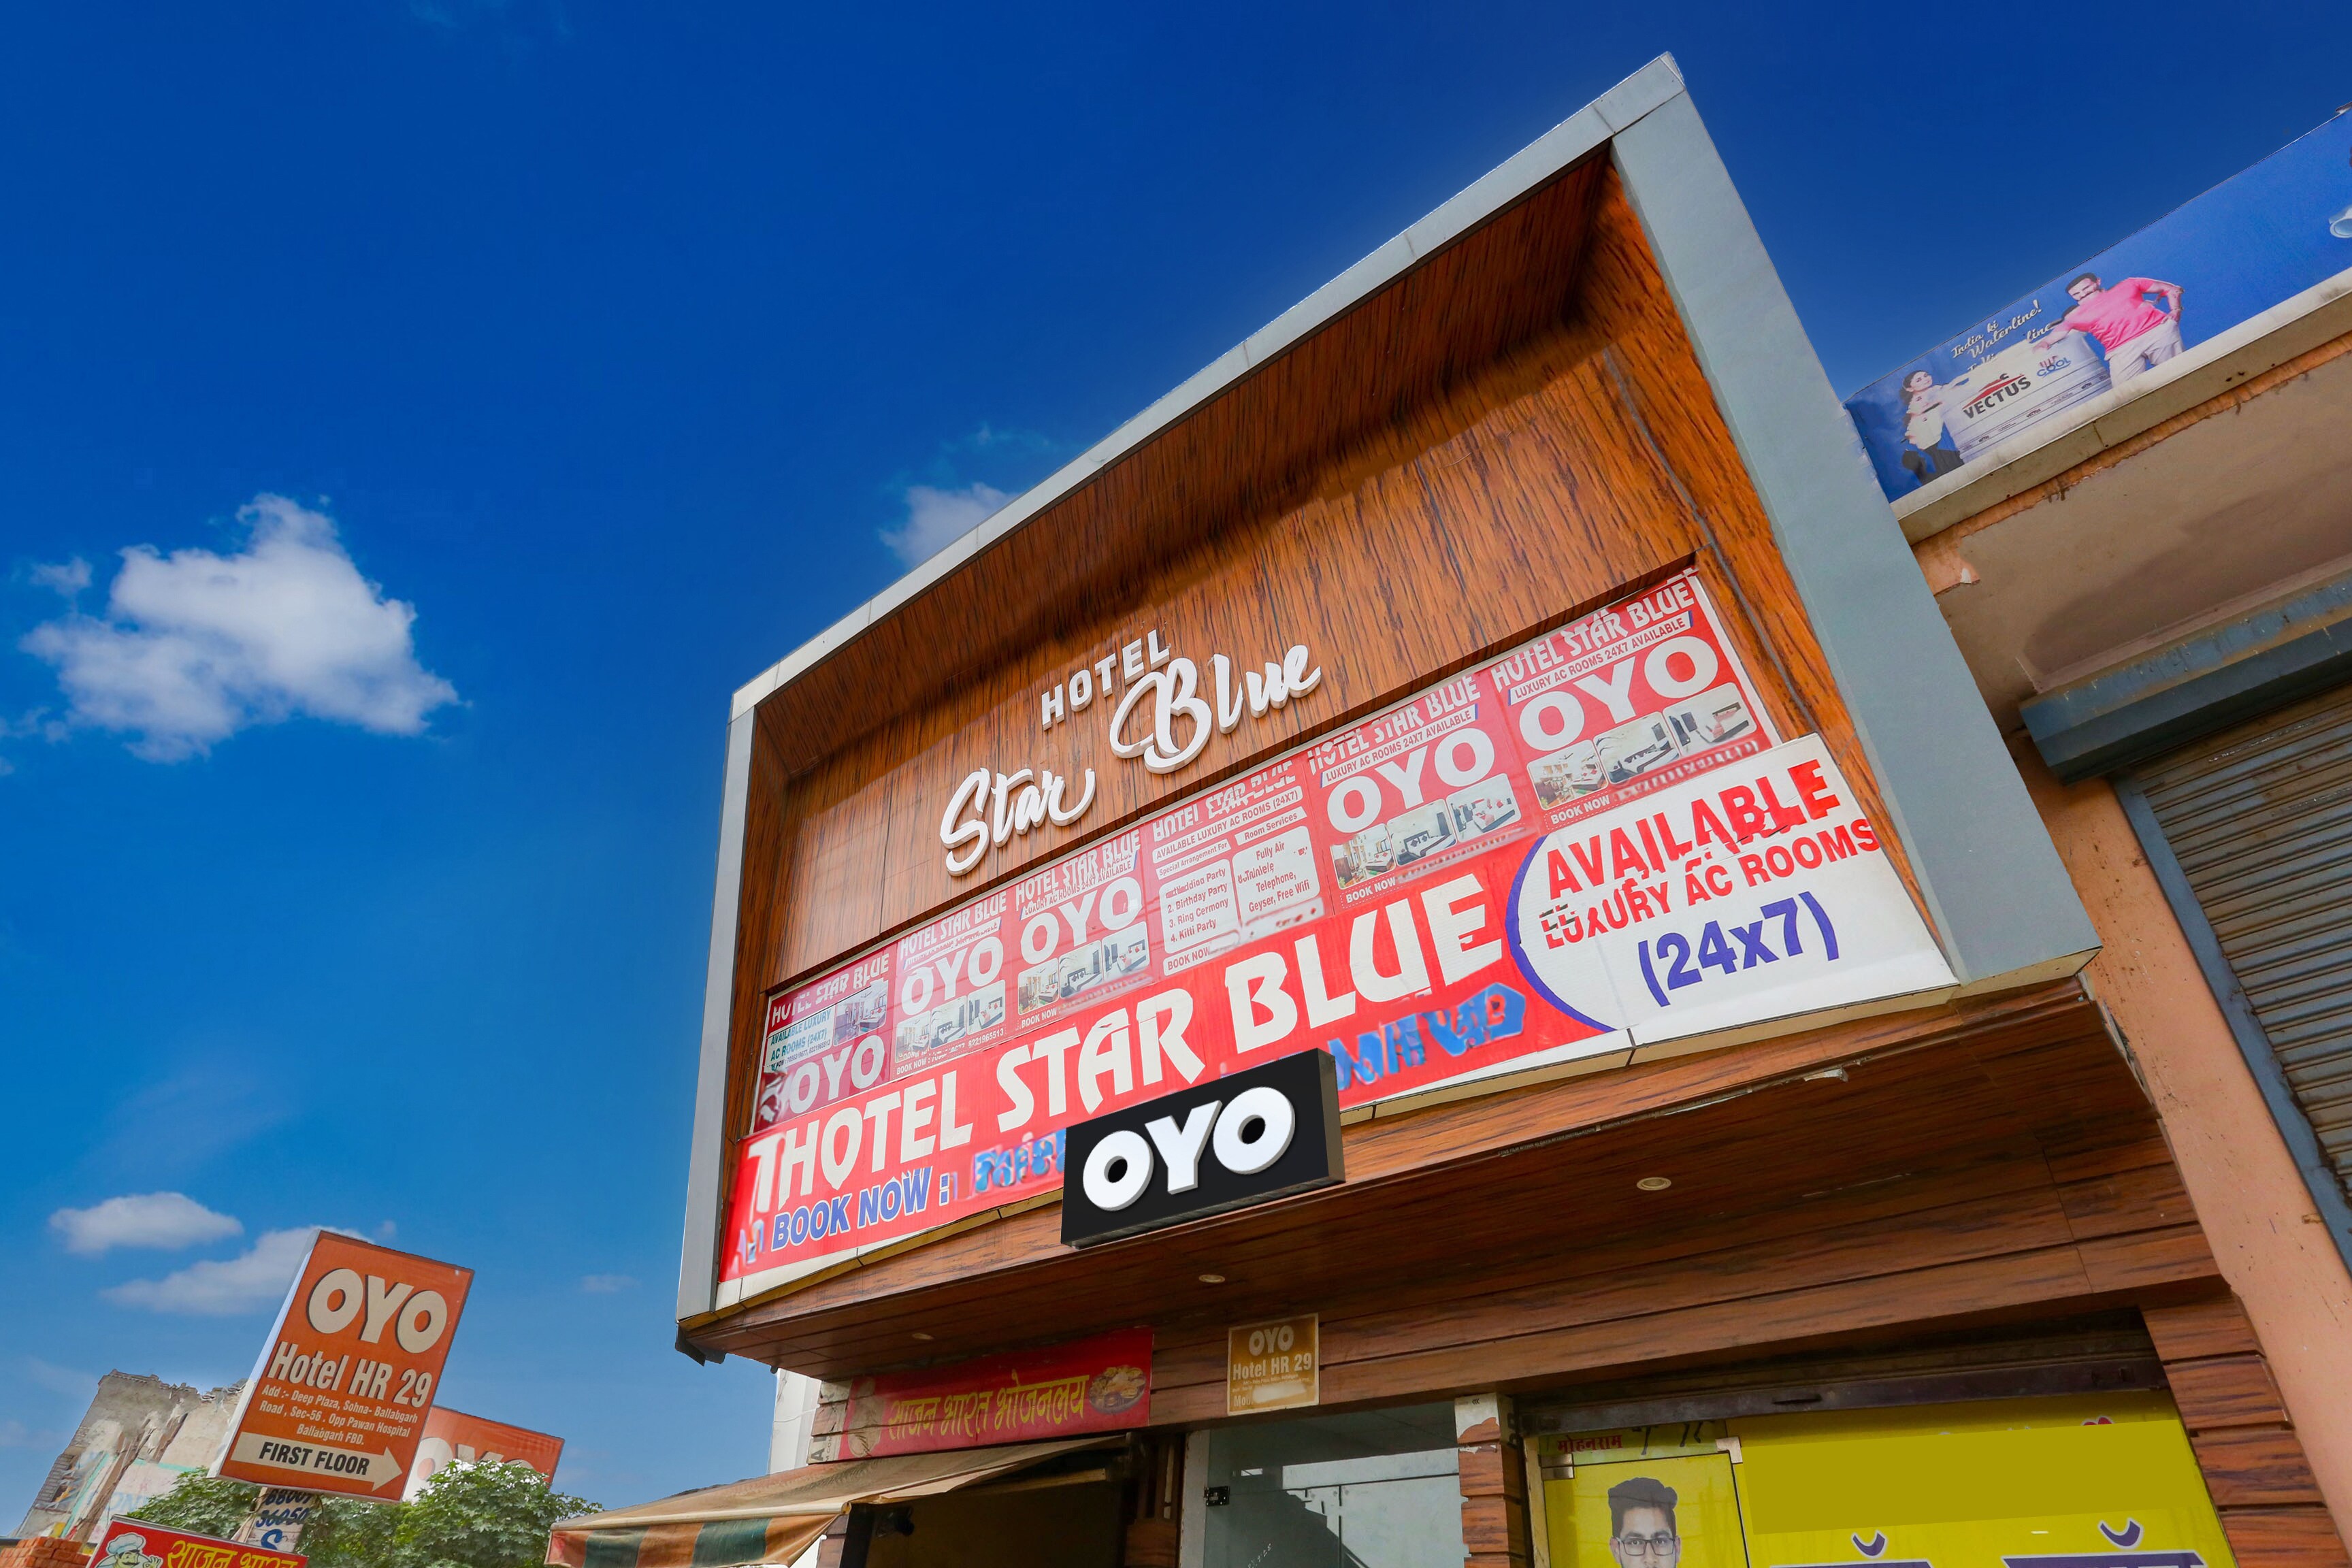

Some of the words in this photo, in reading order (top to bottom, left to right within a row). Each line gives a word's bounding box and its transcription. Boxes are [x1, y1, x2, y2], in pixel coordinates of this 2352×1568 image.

[1951, 334, 1984, 358] India
[1987, 321, 1998, 333] ki
[1967, 299, 2042, 358] Waterline!
[1963, 377, 2031, 419] VECTUS
[1490, 647, 1563, 691] HOTEL
[1563, 607, 1629, 657] STAR
[1627, 578, 1694, 630] BLUE
[1515, 676, 1551, 698] LUXURY
[1554, 670, 1567, 683] AC
[1569, 654, 1604, 676] ROOMS
[1605, 642, 1629, 662] 24X7
[1632, 617, 1685, 649] AVAILABLE
[1041, 630, 1171, 731] HOTEL
[1426, 676, 1481, 719] BLUE
[1519, 636, 1718, 751] OYO
[1110, 644, 1322, 774] Blue
[1326, 760, 1357, 781] LUXURY
[1360, 755, 1371, 768] AC
[1373, 741, 1402, 763] ROOMS
[1403, 732, 1424, 749] 24X7
[1425, 710, 1471, 740] AVAILABLE
[1327, 728, 1494, 833] OYO
[940, 767, 1096, 876] Star
[1156, 836, 1196, 860] AVAILABLE
[1197, 822, 1227, 842] LUXURY
[1229, 815, 1241, 828] AC
[1242, 802, 1271, 821] ROOMS
[1273, 789, 1299, 810] (24X7)
[1244, 825, 1265, 840] Room
[1267, 813, 1297, 832] Services
[1547, 760, 1840, 899] AVAILABLE
[1550, 806, 1582, 825] BOOK
[1584, 795, 1610, 813] NOW
[1098, 860, 1132, 883] AVAILABLE
[1159, 860, 1181, 877] Special
[1181, 845, 1218, 868] Arrangement
[1218, 841, 1228, 853] For
[1256, 847, 1273, 861] Fully
[1275, 841, 1285, 853] Air
[1686, 864, 1733, 907] AC
[1741, 818, 1880, 887] ROOMS
[1015, 869, 1059, 911] HOTEL
[1206, 868, 1226, 883] Party
[1249, 896, 1276, 913] Geyser,
[1277, 888, 1294, 903] Free
[1295, 879, 1309, 894] Wifi
[1256, 872, 1296, 893] Telephone,
[1346, 886, 1372, 904] BOOK
[1375, 876, 1396, 892] NOW
[1167, 904, 1175, 913] 2.
[1175, 890, 1206, 911] Birthday
[1208, 882, 1228, 898] Party
[1169, 919, 1176, 928] 3.
[1177, 909, 1194, 926] Ring
[1196, 898, 1228, 918] Cermony
[900, 924, 937, 960] HOTEL
[941, 909, 970, 940] STAR
[974, 889, 1007, 924] BLUE
[1021, 877, 1143, 964] OYO
[1171, 933, 1177, 943] 4.
[1179, 926, 1195, 940] Kitti
[1197, 917, 1216, 933] Party
[1167, 954, 1190, 971] BOOK
[1638, 892, 1839, 1007] (24x7)
[901, 936, 1004, 1015] OYO
[996, 987, 1206, 1132] STAR
[1225, 874, 1502, 1053] BLUE
[1021, 1013, 1040, 1029] BOOK
[1041, 1006, 1057, 1020] NOW
[770, 1048, 780, 1061] AC
[782, 1037, 806, 1057] ROOMS
[808, 1028, 827, 1047] (24X7)
[771, 1026, 803, 1045] AVAILABLE
[804, 1010, 832, 1030] LUXURY
[789, 1034, 885, 1114] OYO
[896, 1063, 913, 1075] BOOK
[913, 1056, 927, 1069] NOW
[1083, 1087, 1295, 1211] OYO
[771, 1193, 853, 1252] BOOK
[857, 1167, 933, 1229] NOW
[307, 1268, 448, 1354] OYO
[1248, 1325, 1294, 1356] OYO
[267, 1341, 350, 1391] Hotel
[348, 1358, 393, 1401] HR
[394, 1369, 433, 1408] 29
[1232, 1359, 1267, 1380] Hotel
[1271, 1356, 1290, 1375] HR
[1294, 1352, 1312, 1372] 29
[259, 1401, 283, 1414] Road
[290, 1406, 321, 1422] Sec-56
[328, 1413, 346, 1428] Opp
[347, 1417, 375, 1431] Pawan
[376, 1422, 410, 1438] Hospital
[261, 1384, 281, 1397] Add
[291, 1390, 313, 1405] Deep
[315, 1394, 340, 1411] Plaza,
[343, 1400, 372, 1415] Sohna-
[374, 1406, 418, 1423] Ballabgarh
[888, 1396, 941, 1440] साजन
[941, 1391, 994, 1437] भारत
[297, 1424, 344, 1441] Ballabgarh
[345, 1433, 364, 1446] FBD.
[1557, 1434, 1623, 1453] मोहनराम
[259, 1441, 313, 1466] FIRST
[314, 1450, 370, 1475] FLOOR
